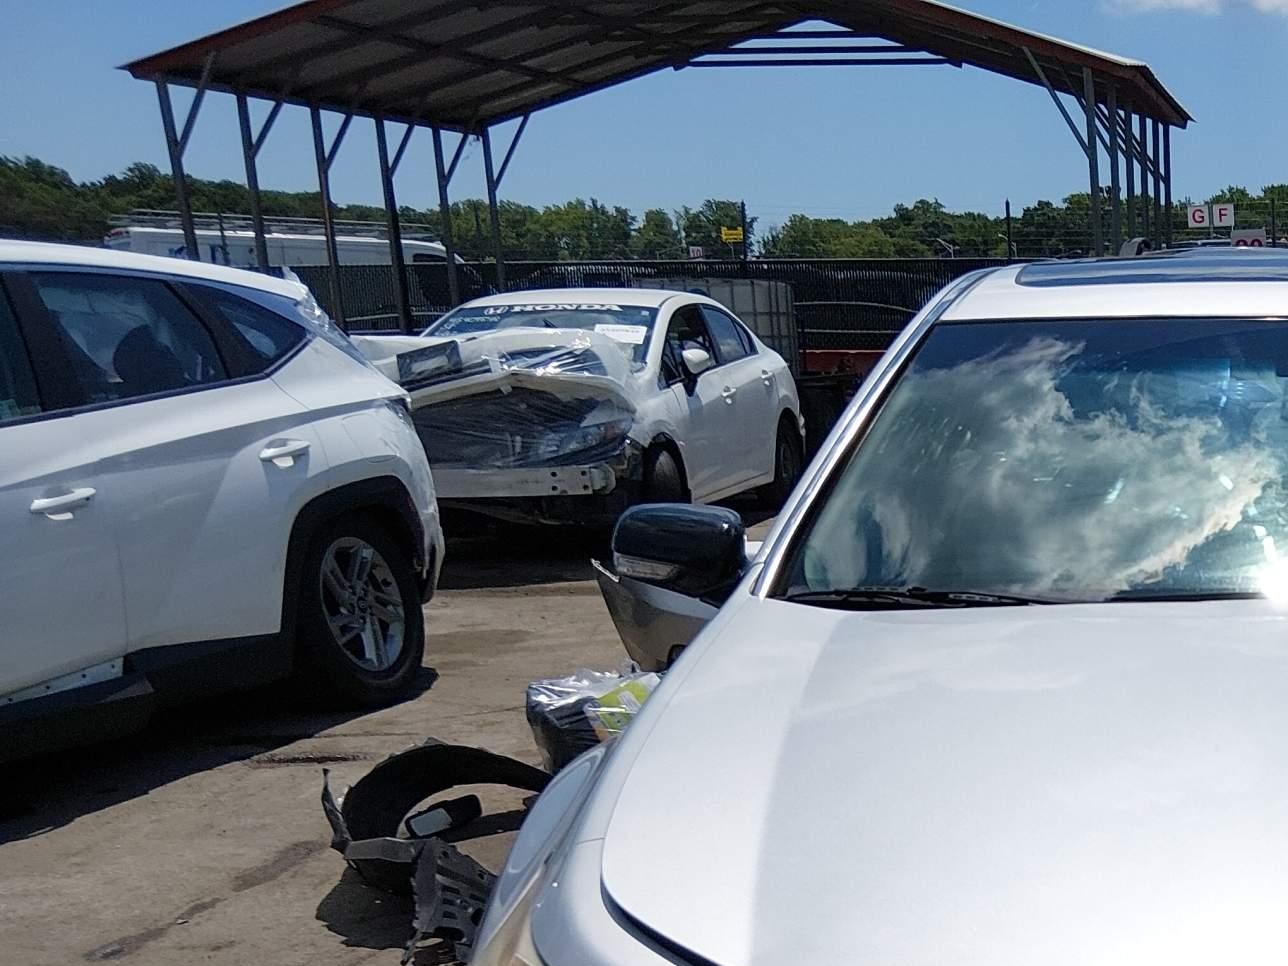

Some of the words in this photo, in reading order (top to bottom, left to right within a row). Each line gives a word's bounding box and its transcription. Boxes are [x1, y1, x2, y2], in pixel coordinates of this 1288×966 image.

[1192, 208, 1205, 223] G
[1218, 207, 1228, 222] F
[510, 304, 623, 312] HONDA
